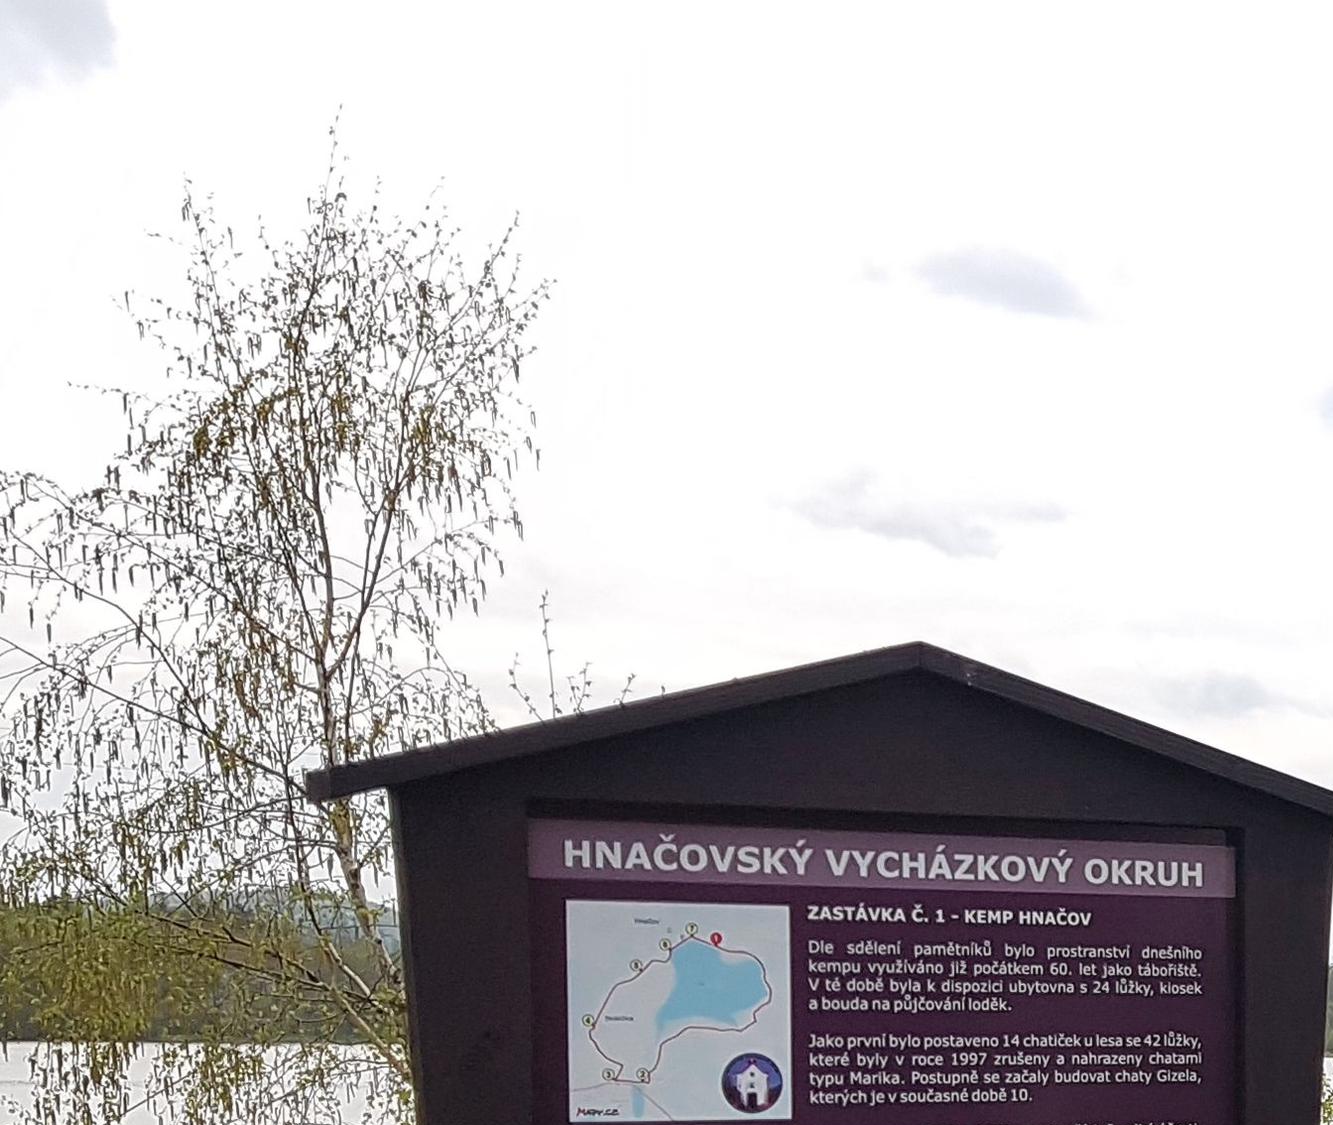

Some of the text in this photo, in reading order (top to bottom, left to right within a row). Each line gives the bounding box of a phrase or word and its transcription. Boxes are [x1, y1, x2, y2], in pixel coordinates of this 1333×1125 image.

[565, 834, 1202, 886] HNAČOVSKÝ VYCHÁZKOVÝ OKRUH
[807, 902, 905, 921] ZASTÁVKA
[911, 904, 928, 922] Č.
[936, 909, 944, 922] 1
[964, 909, 1013, 923] KEMP
[1019, 907, 1091, 925] HNAČOV
[808, 940, 1201, 959] Dle sdělení pamětníků bylo prostranství dnešního
[809, 959, 860, 975] kempu
[867, 960, 943, 975] využíváno
[949, 961, 966, 976] již
[974, 962, 1043, 976] počátkem
[1079, 963, 1096, 975] let
[1101, 963, 1131, 981] jako
[1138, 964, 1201, 976] tábořiště.
[808, 978, 819, 990] V
[846, 978, 883, 991] době
[890, 978, 920, 996] byla
[927, 979, 935, 992] k
[941, 979, 1002, 995] dispozici
[1009, 979, 1074, 995] ubytovna
[1080, 983, 1087, 993] s
[1093, 981, 1109, 993] 24
[1160, 981, 1202, 994] kiosek
[809, 997, 1011, 1013] a bouda na půjčování loděk.
